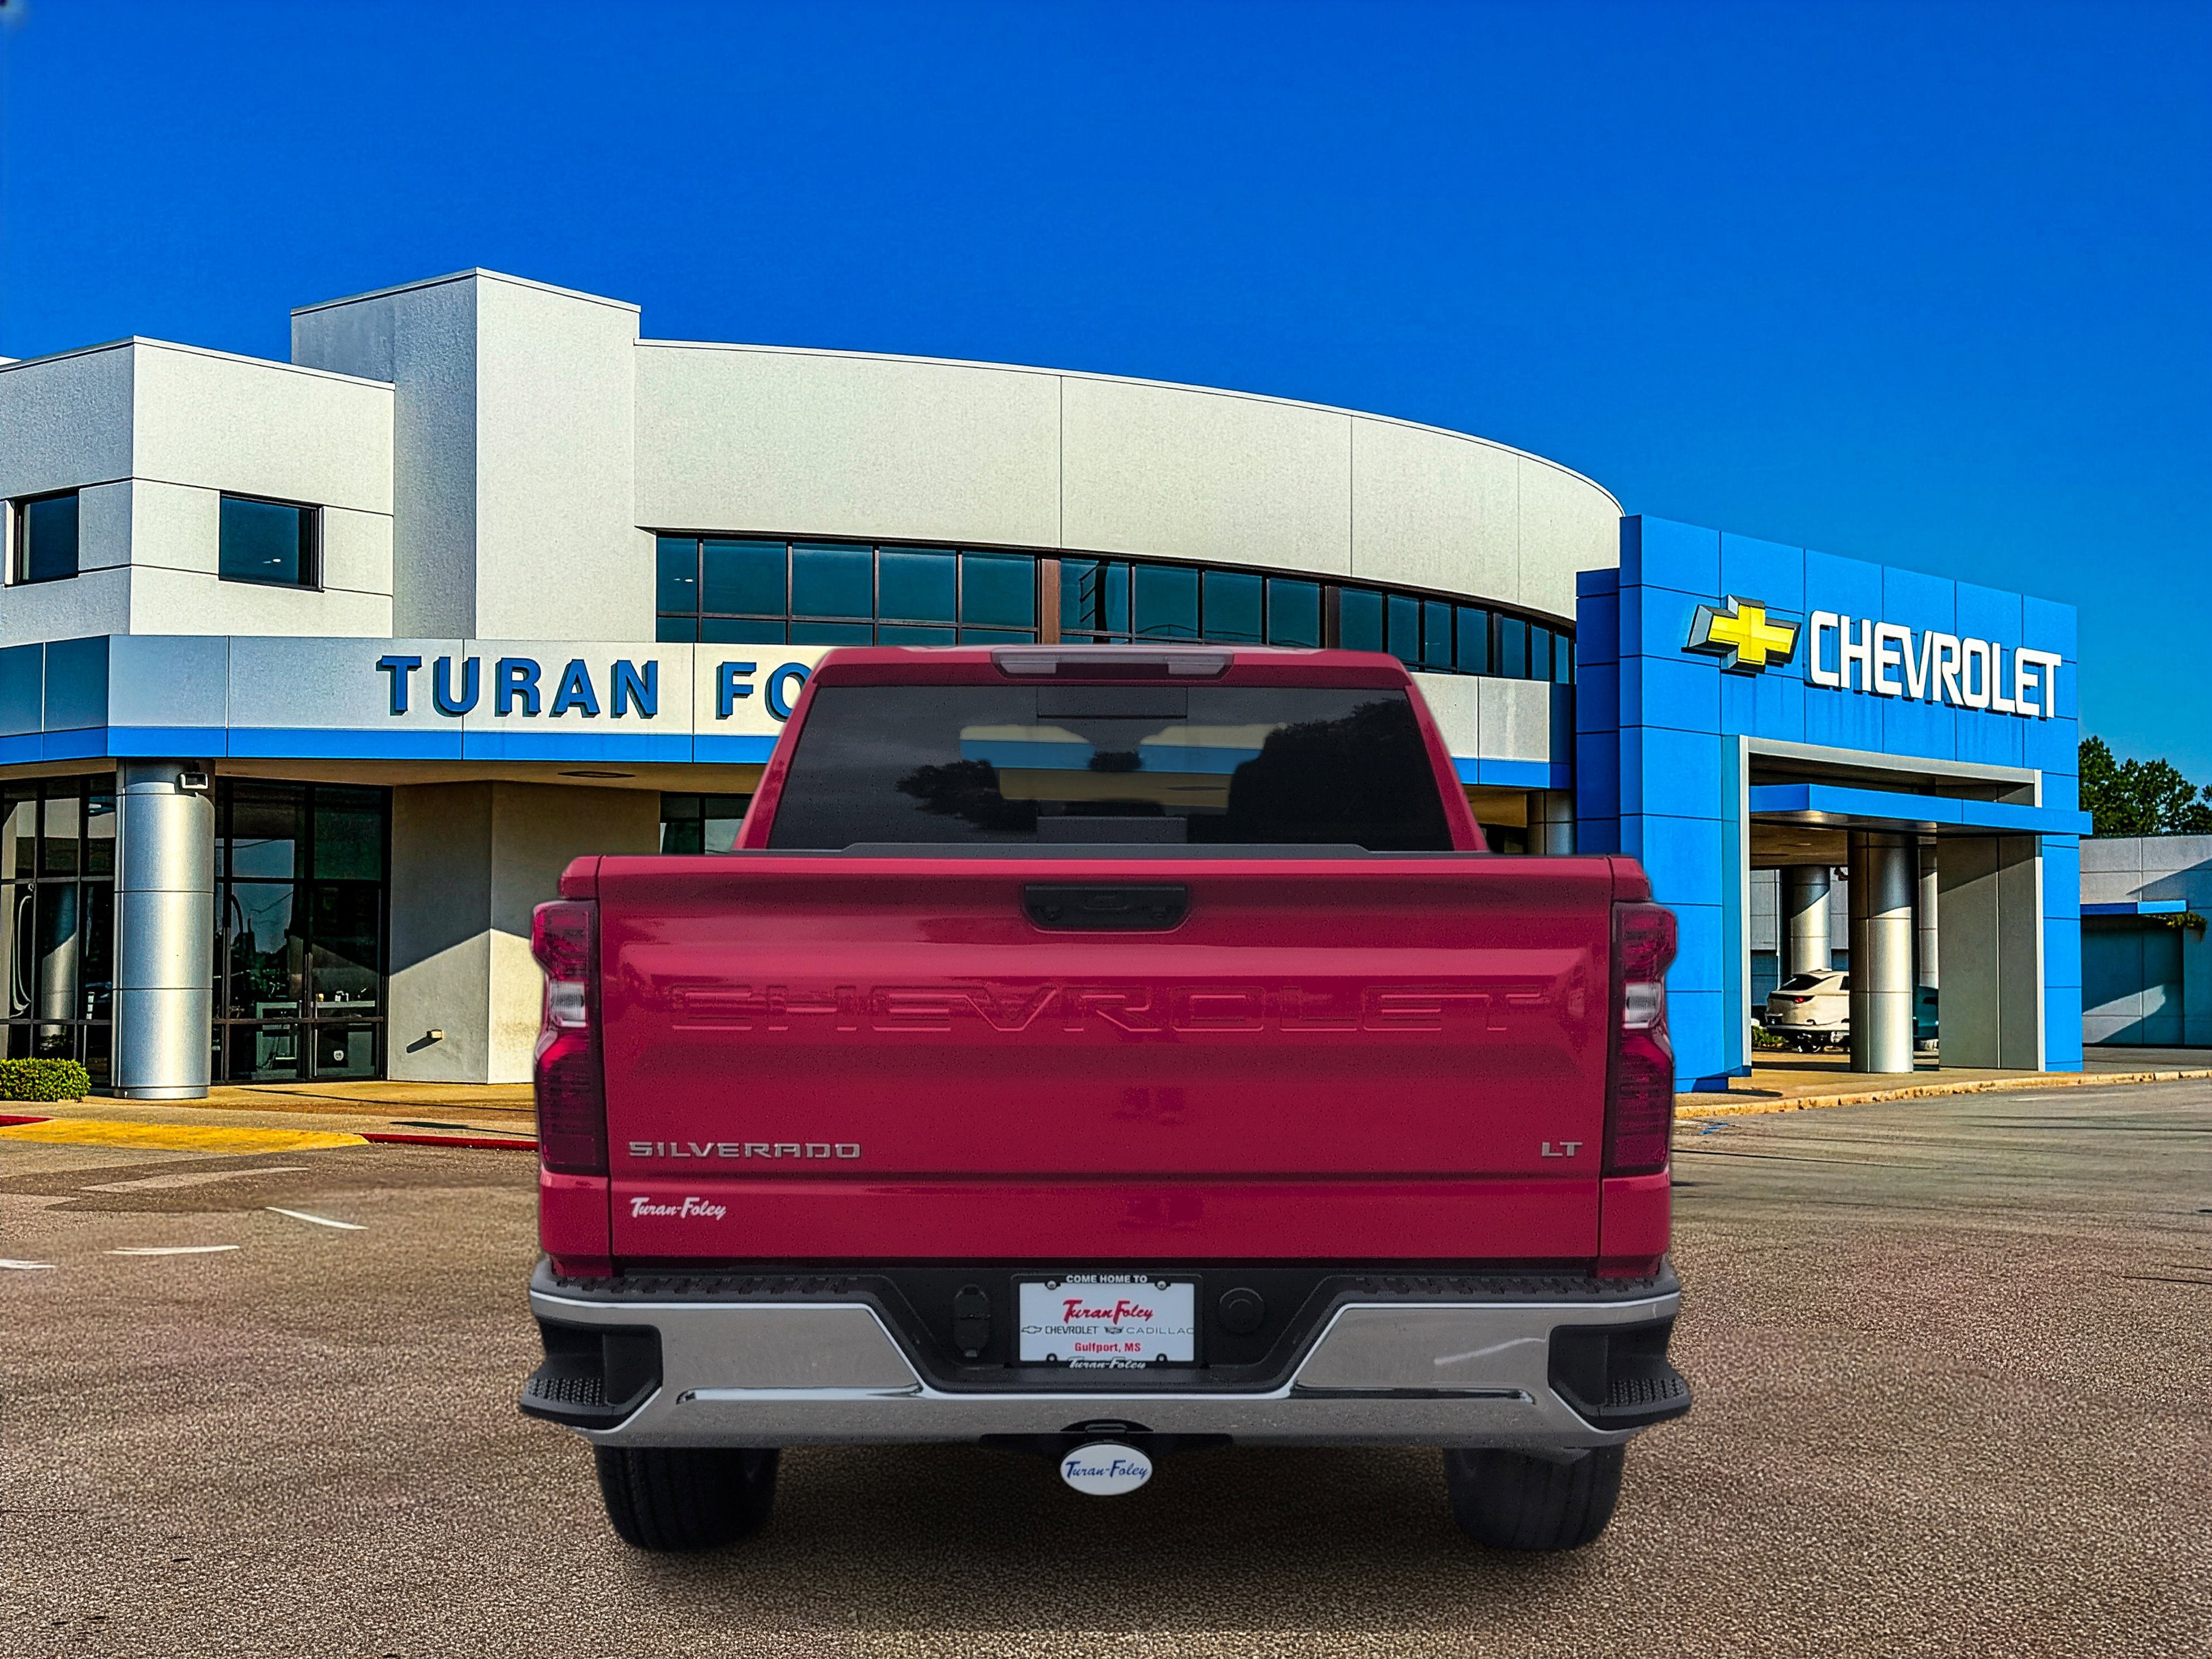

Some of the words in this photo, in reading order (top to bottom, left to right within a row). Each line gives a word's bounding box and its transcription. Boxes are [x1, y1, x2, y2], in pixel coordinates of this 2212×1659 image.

[1810, 610, 2061, 718] CHEVROLET
[376, 655, 659, 719] TURAN
[670, 985, 1553, 1033] CHEVROLET
[628, 1141, 861, 1158] SILVERADO
[1541, 1141, 1583, 1156] LT
[630, 1197, 727, 1220] Turan-Foley
[1045, 1326, 1099, 1335] CHEVROLET
[1126, 1327, 1194, 1335] CADILLAC
[1075, 1342, 1121, 1353] Gulfport,
[1124, 1342, 1141, 1352] MS
[1065, 1459, 1148, 1480] Turan-Foley
